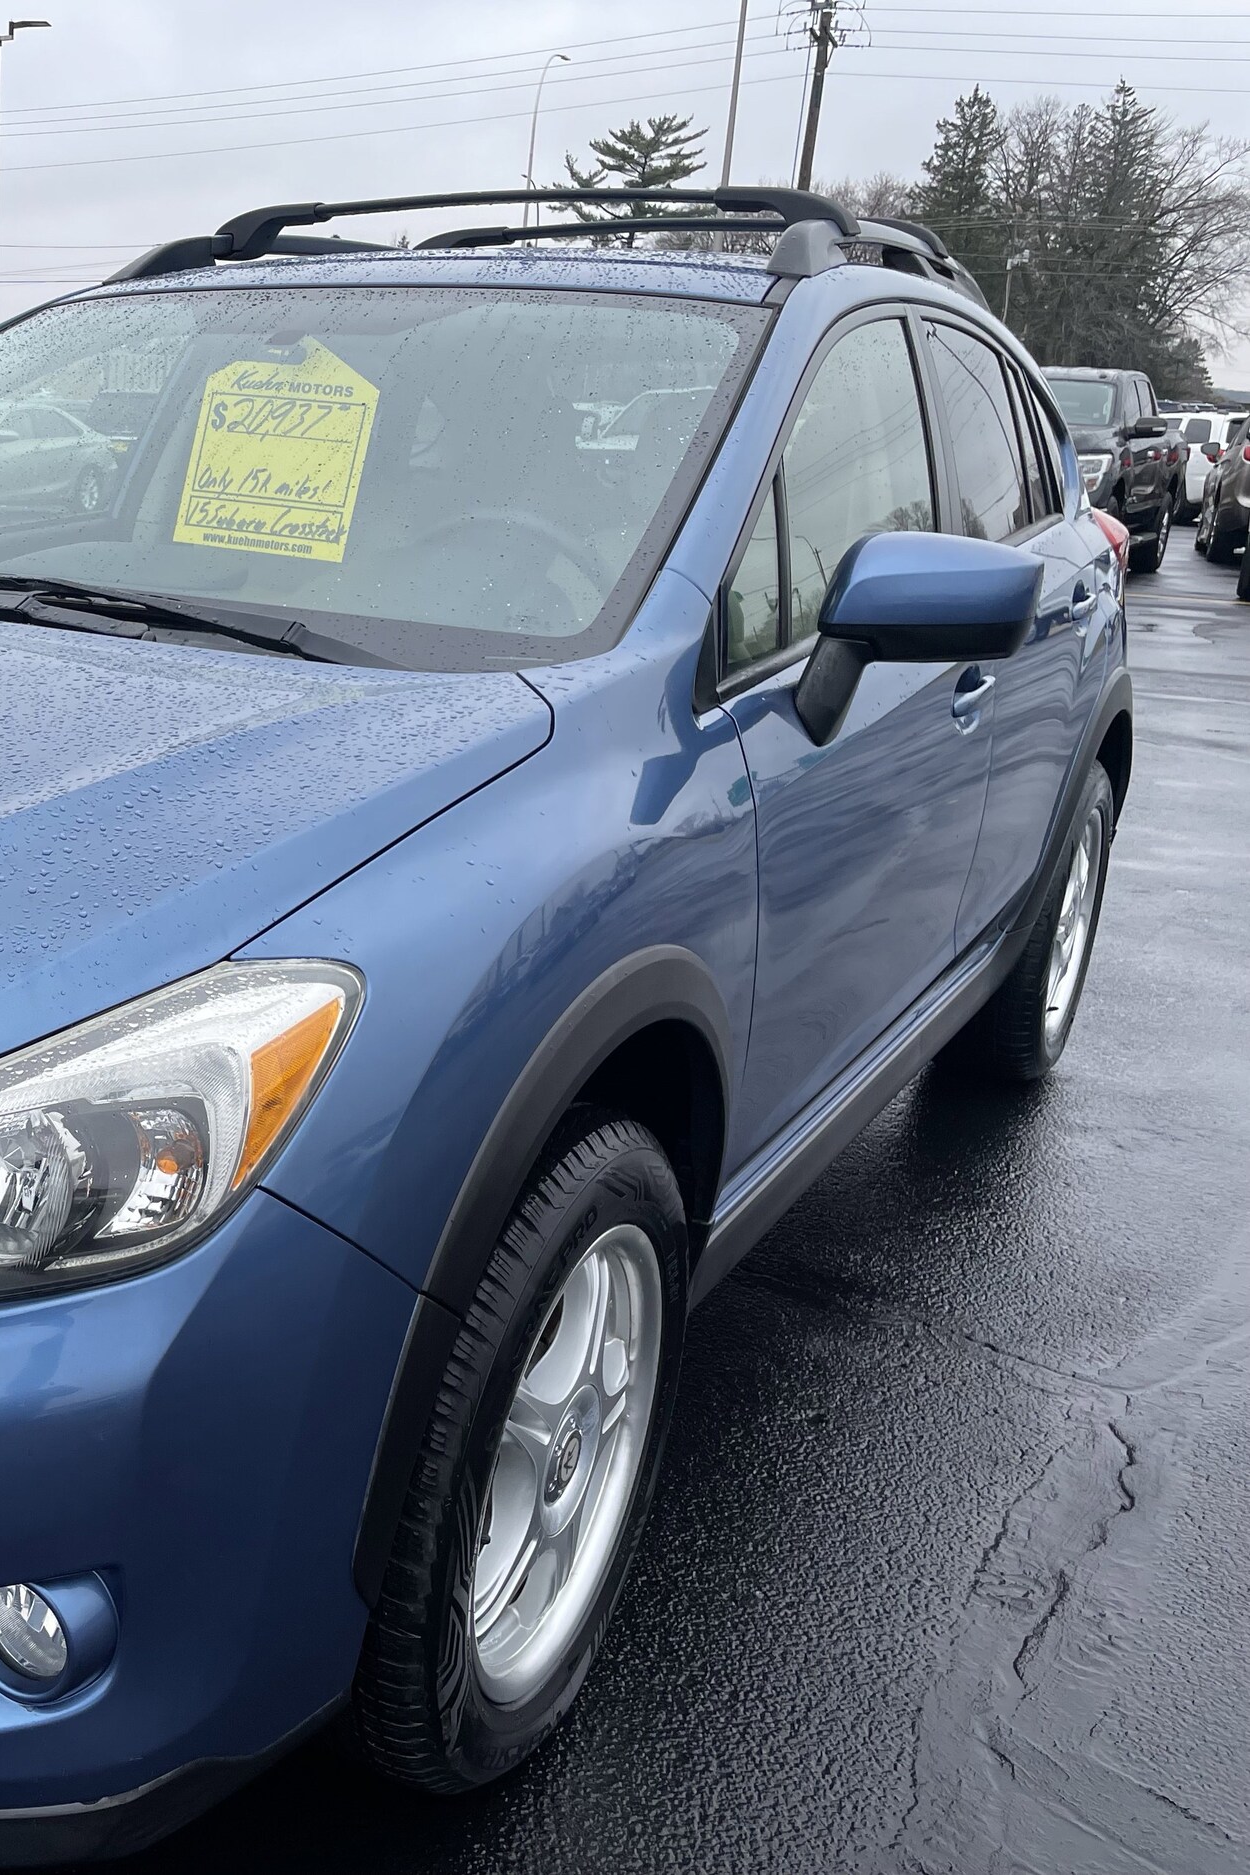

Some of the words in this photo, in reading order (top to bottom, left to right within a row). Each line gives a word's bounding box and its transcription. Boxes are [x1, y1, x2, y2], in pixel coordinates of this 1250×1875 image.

[231, 370, 284, 391] Kuehn
[288, 381, 354, 398] MOTORS
[198, 466, 233, 498] Only
[203, 532, 312, 554] www.kuehnmotors.com
